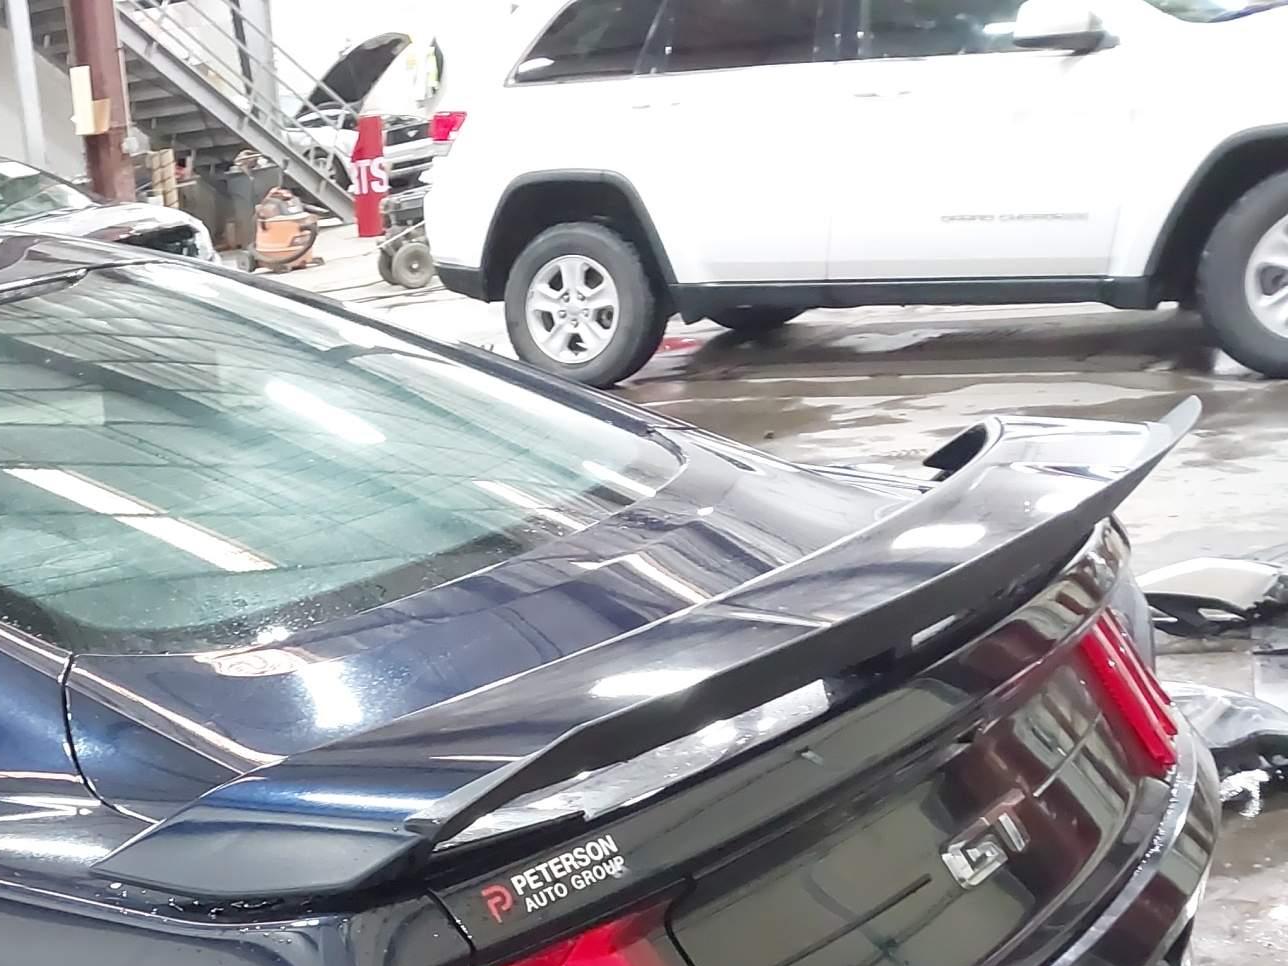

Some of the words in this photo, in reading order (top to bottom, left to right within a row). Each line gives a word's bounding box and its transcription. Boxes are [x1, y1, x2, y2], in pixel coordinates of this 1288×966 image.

[510, 834, 618, 896] PETERSON
[941, 788, 1030, 890] GT
[524, 882, 568, 913] AUTO
[570, 856, 625, 890] GROUP
